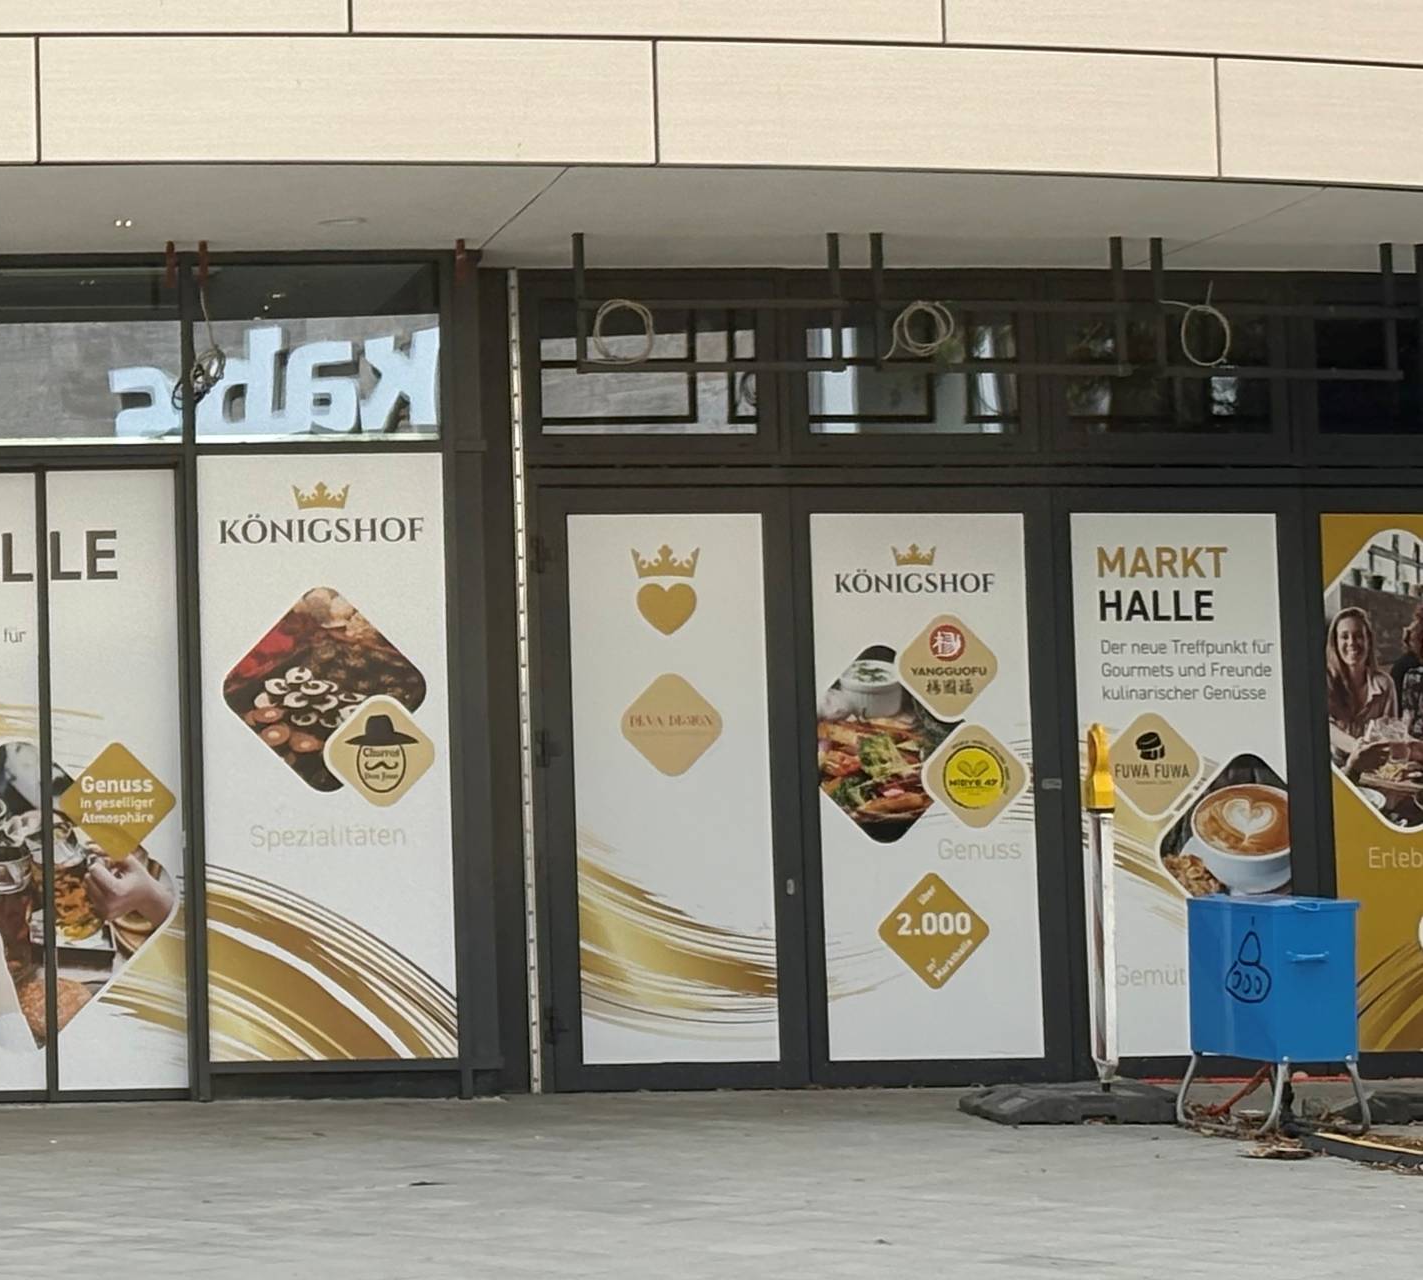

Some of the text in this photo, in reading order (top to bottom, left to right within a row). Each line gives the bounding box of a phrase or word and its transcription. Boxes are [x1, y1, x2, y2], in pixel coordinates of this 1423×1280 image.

[219, 514, 424, 545] KÖNIGSHOF
[1096, 546, 1228, 578] MARKT
[835, 569, 995, 594] KÖNIGSHOF
[1099, 590, 1214, 622] HALLE
[4, 628, 26, 643] für
[1101, 639, 1274, 657] Der neue Treffpunkt für
[911, 666, 987, 676] YANGGUOFU
[1101, 662, 1272, 678] Gourmets und Freunde
[1102, 684, 1267, 701] kulinarischer Genüsse
[1114, 763, 1190, 778] FUWA FUWA
[81, 776, 153, 794] Genuss
[80, 797, 154, 811] in geselliger
[81, 812, 153, 826] Atmosphäre
[250, 824, 407, 851] Spezialitäten
[938, 838, 1022, 860] Genuss
[1368, 846, 1423, 869] Erleb
[896, 912, 972, 936] 2.000
